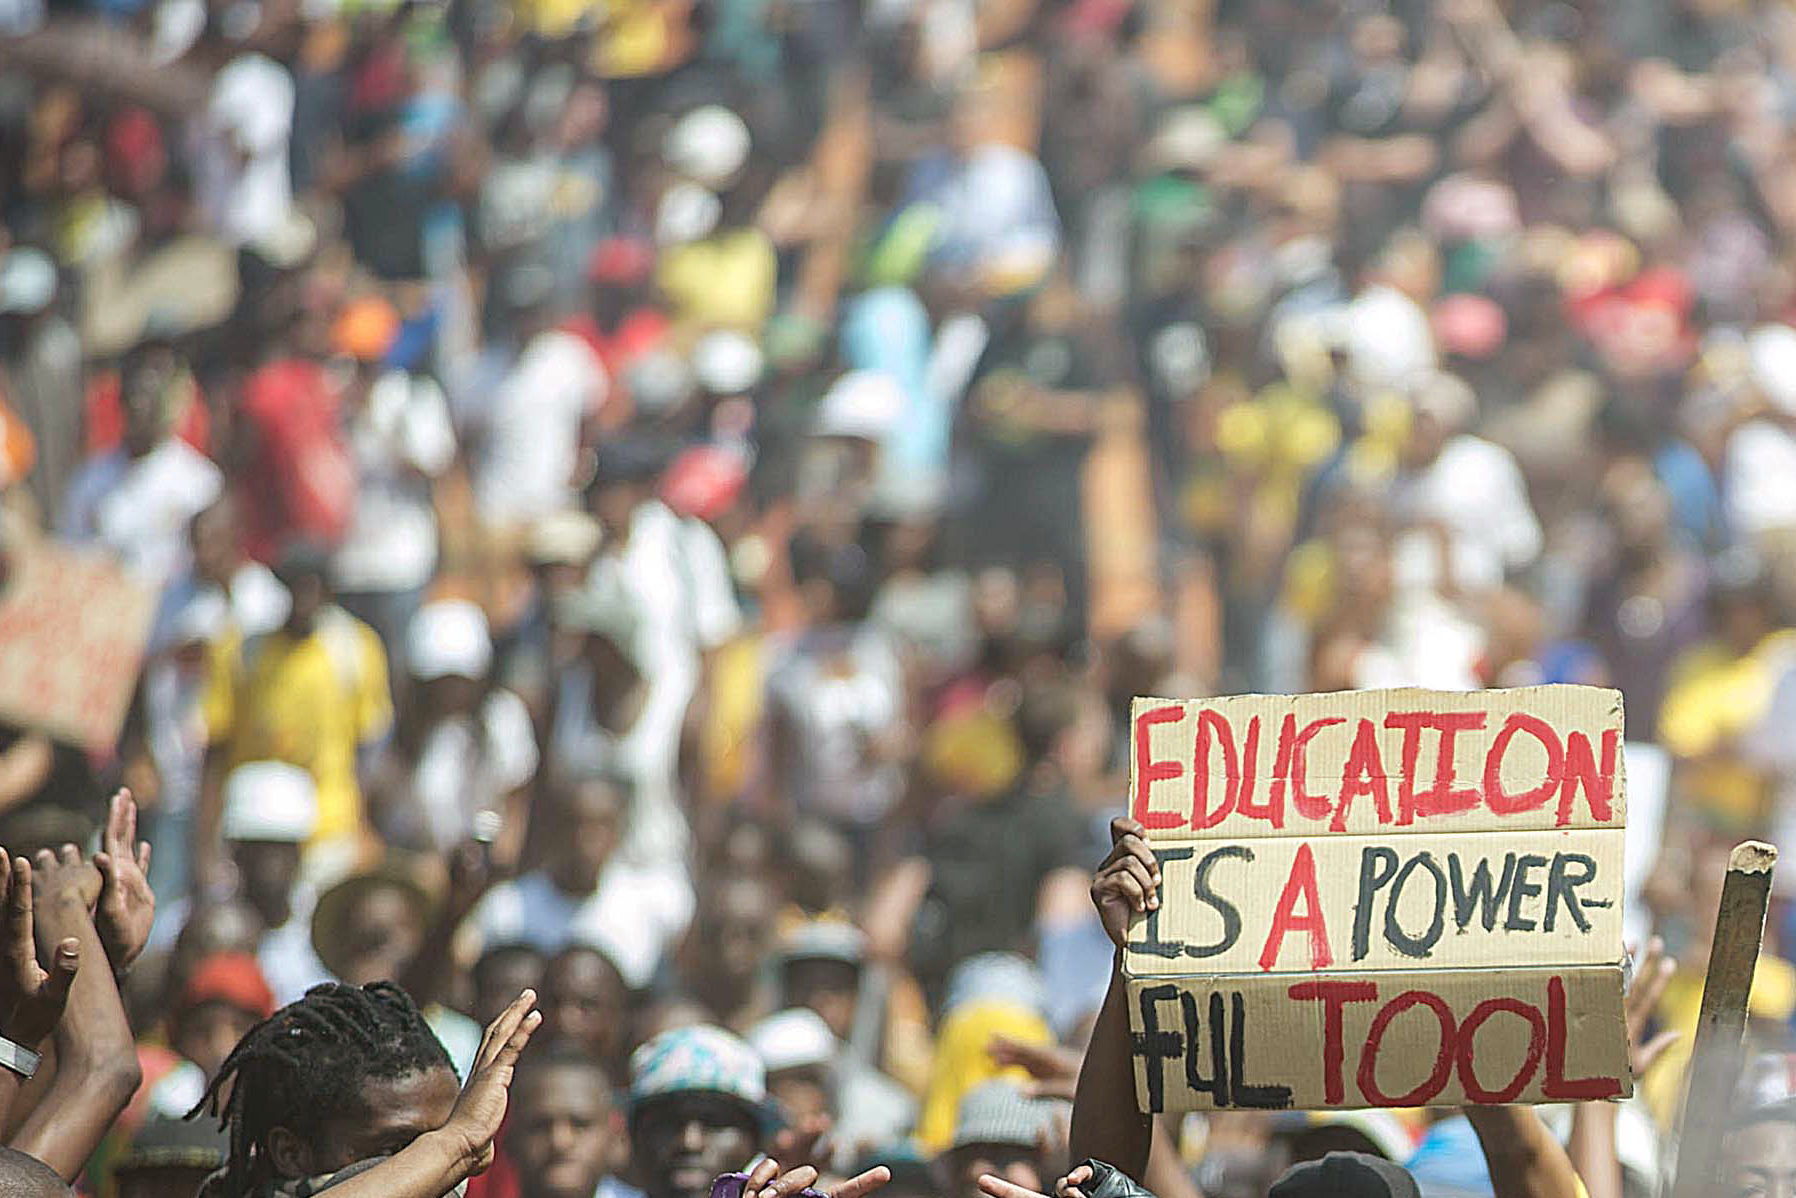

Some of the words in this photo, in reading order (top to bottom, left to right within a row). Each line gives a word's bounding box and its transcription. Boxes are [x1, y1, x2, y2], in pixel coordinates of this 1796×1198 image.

[1131, 706, 1618, 832] EDUCATION
[1130, 846, 1254, 959] IS
[1259, 843, 1333, 972] A
[1351, 846, 1613, 962] POWER-
[1132, 985, 1293, 1113] FUL
[1288, 976, 1622, 1108] TOOL
